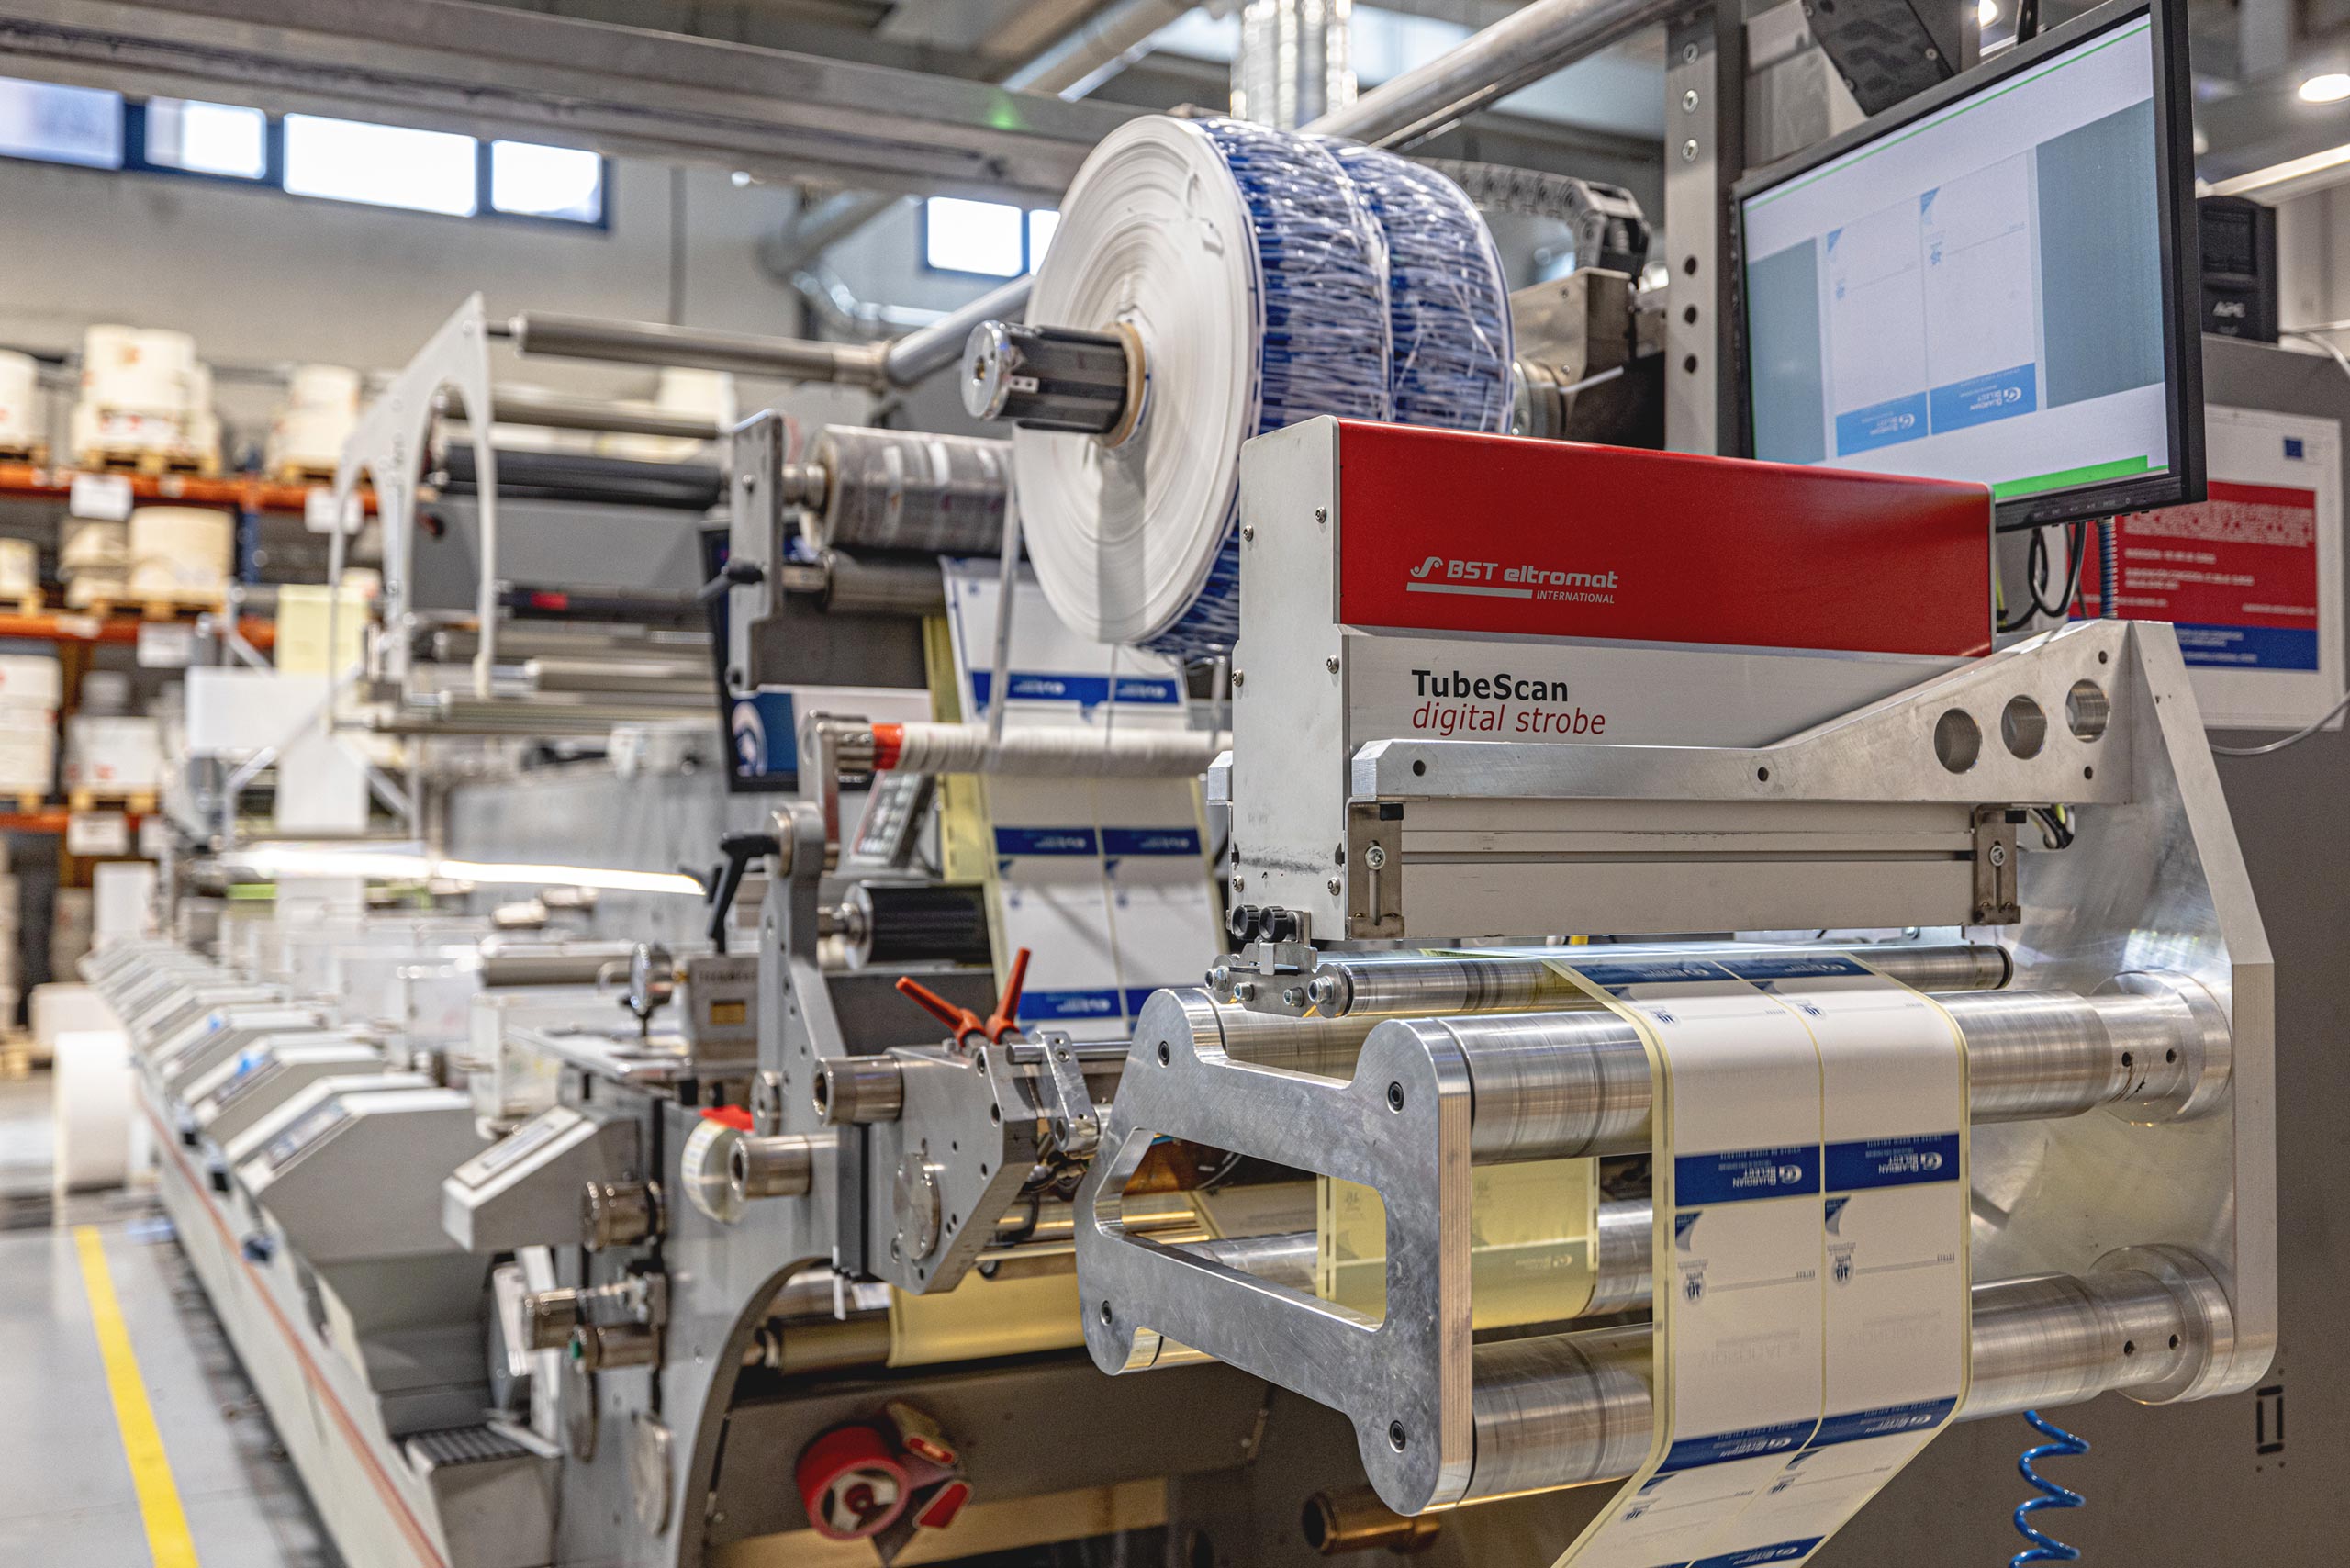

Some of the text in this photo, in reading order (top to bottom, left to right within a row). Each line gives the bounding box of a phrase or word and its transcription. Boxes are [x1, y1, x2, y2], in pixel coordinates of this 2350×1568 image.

[1447, 559, 1618, 588] BST eltromat
[1537, 590, 1615, 604] INTERNATIONAL
[1412, 669, 1568, 702] TubeScan
[1413, 701, 1606, 736] digital strobe
